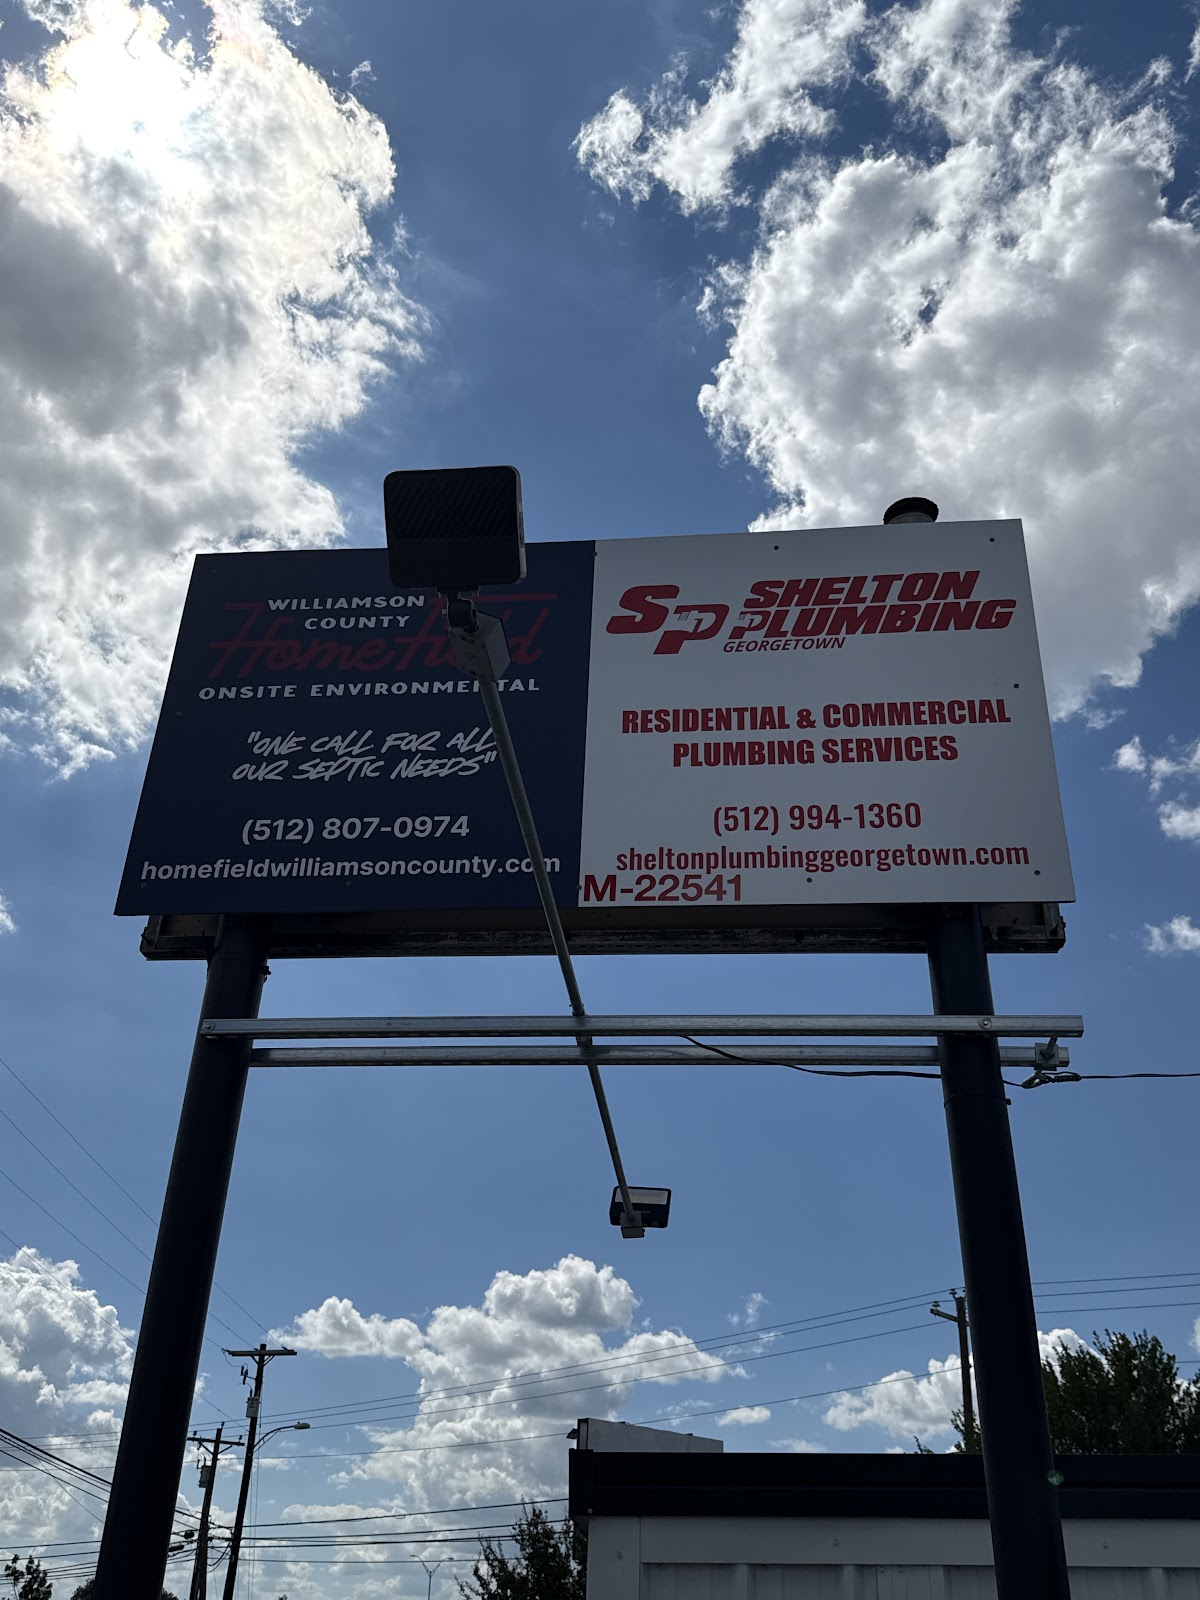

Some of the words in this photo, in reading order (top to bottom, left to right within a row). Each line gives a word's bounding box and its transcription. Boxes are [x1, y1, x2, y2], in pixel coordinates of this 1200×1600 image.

[268, 595, 425, 611] WILLIAMSON
[743, 570, 980, 609] SHELTON
[304, 615, 411, 630] COUNTY
[728, 598, 1017, 640] PLUMBING
[723, 637, 846, 653] GEORGETOWN
[198, 684, 298, 700] ONSITE
[622, 705, 790, 734] RESIDENTIAL
[796, 709, 817, 729] &
[822, 698, 1011, 728] COMMERCIAL
[310, 730, 375, 756] CALL
[380, 731, 442, 753] FOR
[446, 727, 498, 753] ALL
[673, 740, 815, 768] PLUMBING
[821, 735, 959, 763] SERVICES
[231, 759, 289, 781] OUR
[291, 755, 385, 781] SEPTIC
[242, 818, 315, 845] (512)
[322, 815, 470, 840] 807-0974
[713, 806, 780, 836] (512)
[788, 802, 922, 830] 994-1360
[140, 855, 561, 880] homefieldwilliamsoncounty.com
[616, 844, 1030, 872] sheltonplumbinggeorgetown.com
[583, 874, 742, 902] M-22541
